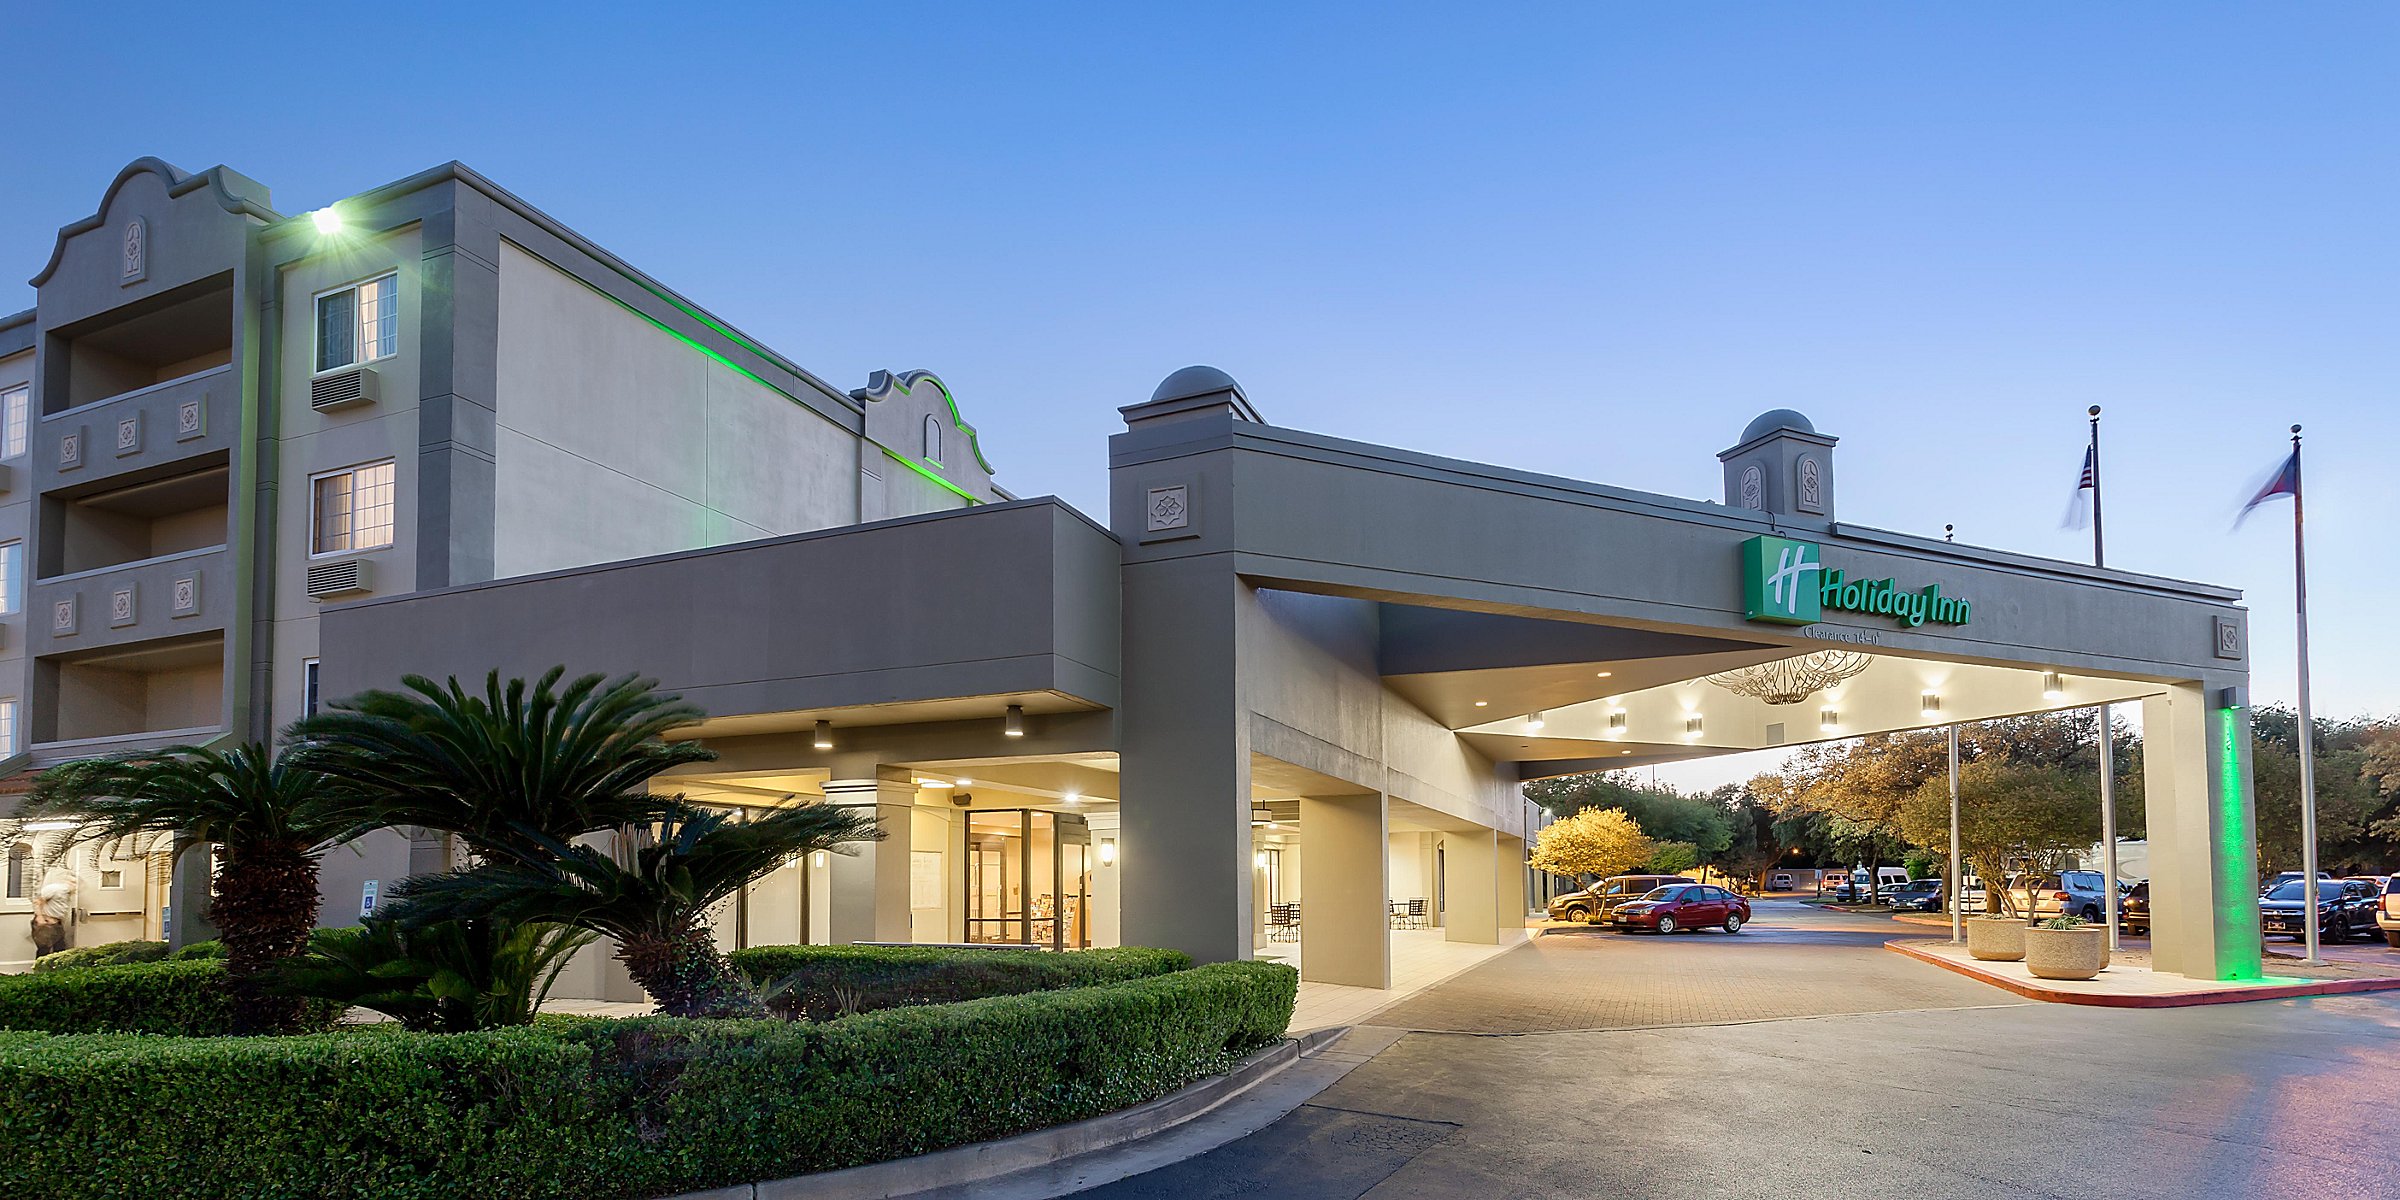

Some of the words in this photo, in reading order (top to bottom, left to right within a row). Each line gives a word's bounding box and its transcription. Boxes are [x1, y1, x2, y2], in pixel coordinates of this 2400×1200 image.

[1768, 545, 1820, 615] H
[1820, 567, 1928, 627] Holiday
[1931, 583, 1971, 624] Inn
[1804, 626, 1850, 642] Clearance
